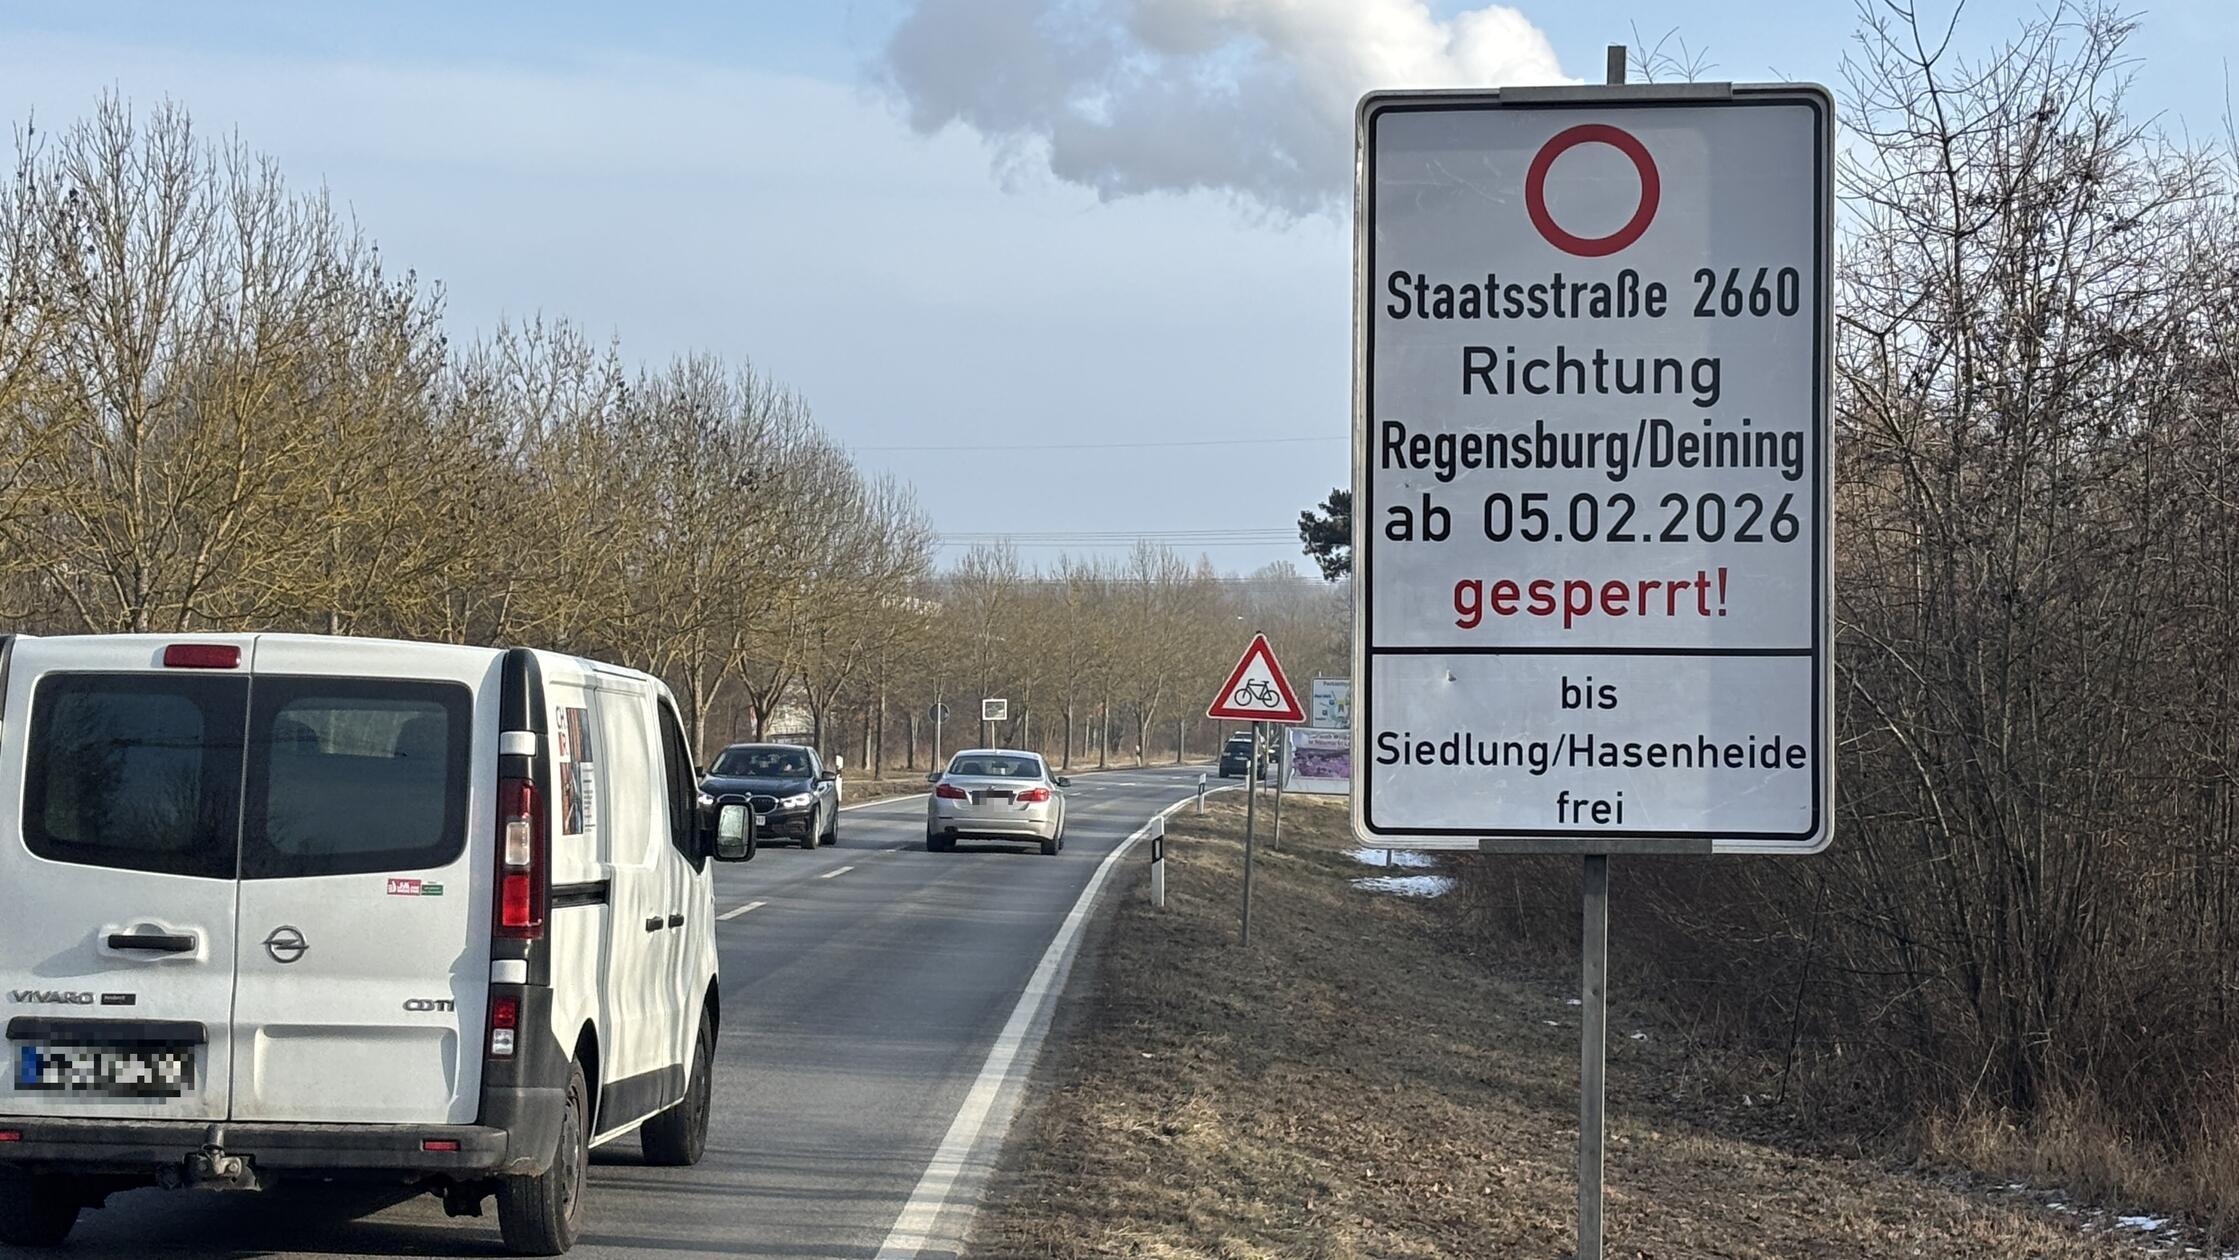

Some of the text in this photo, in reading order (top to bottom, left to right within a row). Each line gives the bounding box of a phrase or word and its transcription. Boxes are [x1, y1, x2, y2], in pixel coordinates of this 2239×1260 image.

[1387, 267, 1799, 319] Staatsstraße 2660
[1463, 346, 1721, 408] Richtung
[1382, 418, 1804, 483] Regensburg/Deining
[1385, 493, 1799, 543] ab 05.02.2026
[1454, 568, 1728, 629] gesperrt!
[1562, 676, 1618, 709] bis
[1376, 732, 1807, 775] Siedlung/Hasenheide
[1557, 791, 1623, 824] frei
[7, 990, 94, 1005] VIVARO
